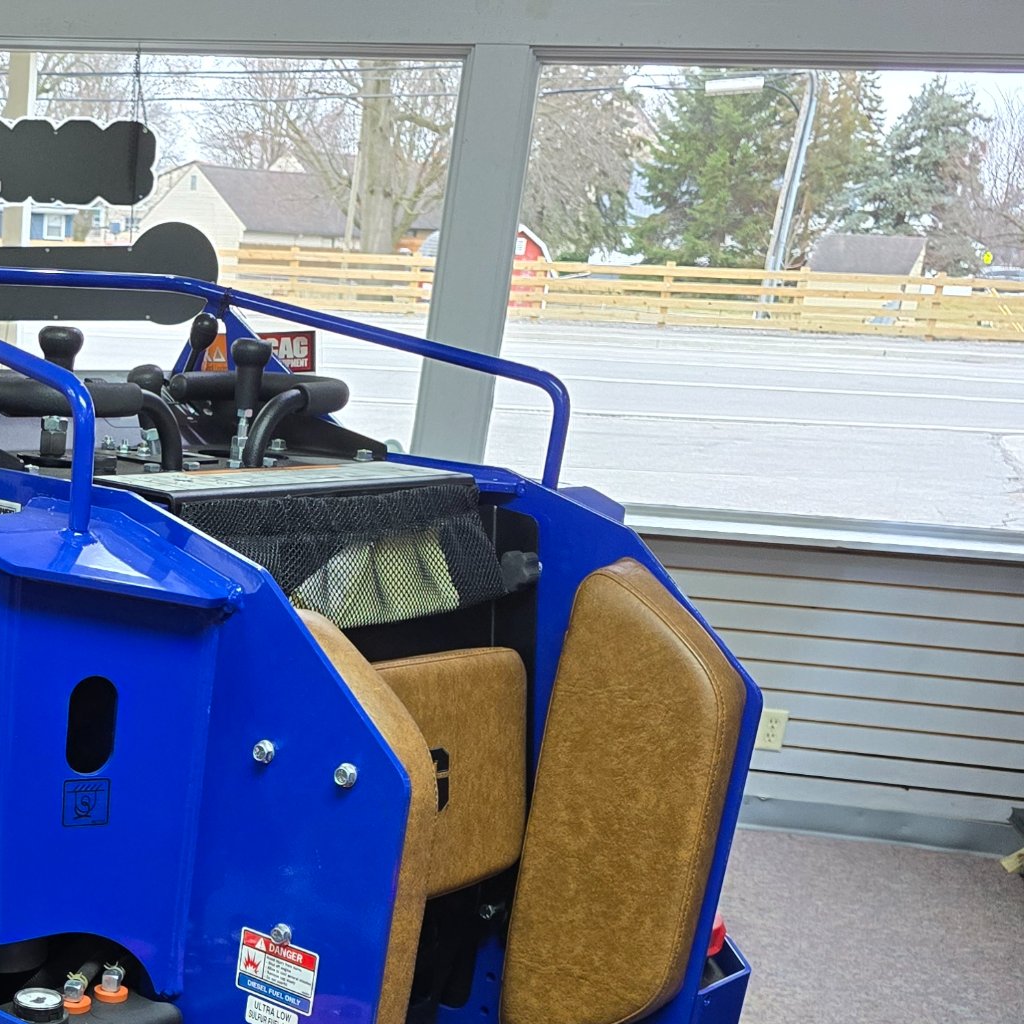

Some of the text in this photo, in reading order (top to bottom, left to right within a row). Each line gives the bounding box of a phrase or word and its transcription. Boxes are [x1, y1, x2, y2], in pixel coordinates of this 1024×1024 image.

[266, 336, 309, 359] CAG
[269, 944, 303, 963] DANGER
[247, 979, 301, 1006] DIESEL FUEL ONLY
[248, 1009, 268, 1024] SULFUR
[254, 1001, 292, 1022] ULTRA LOW
